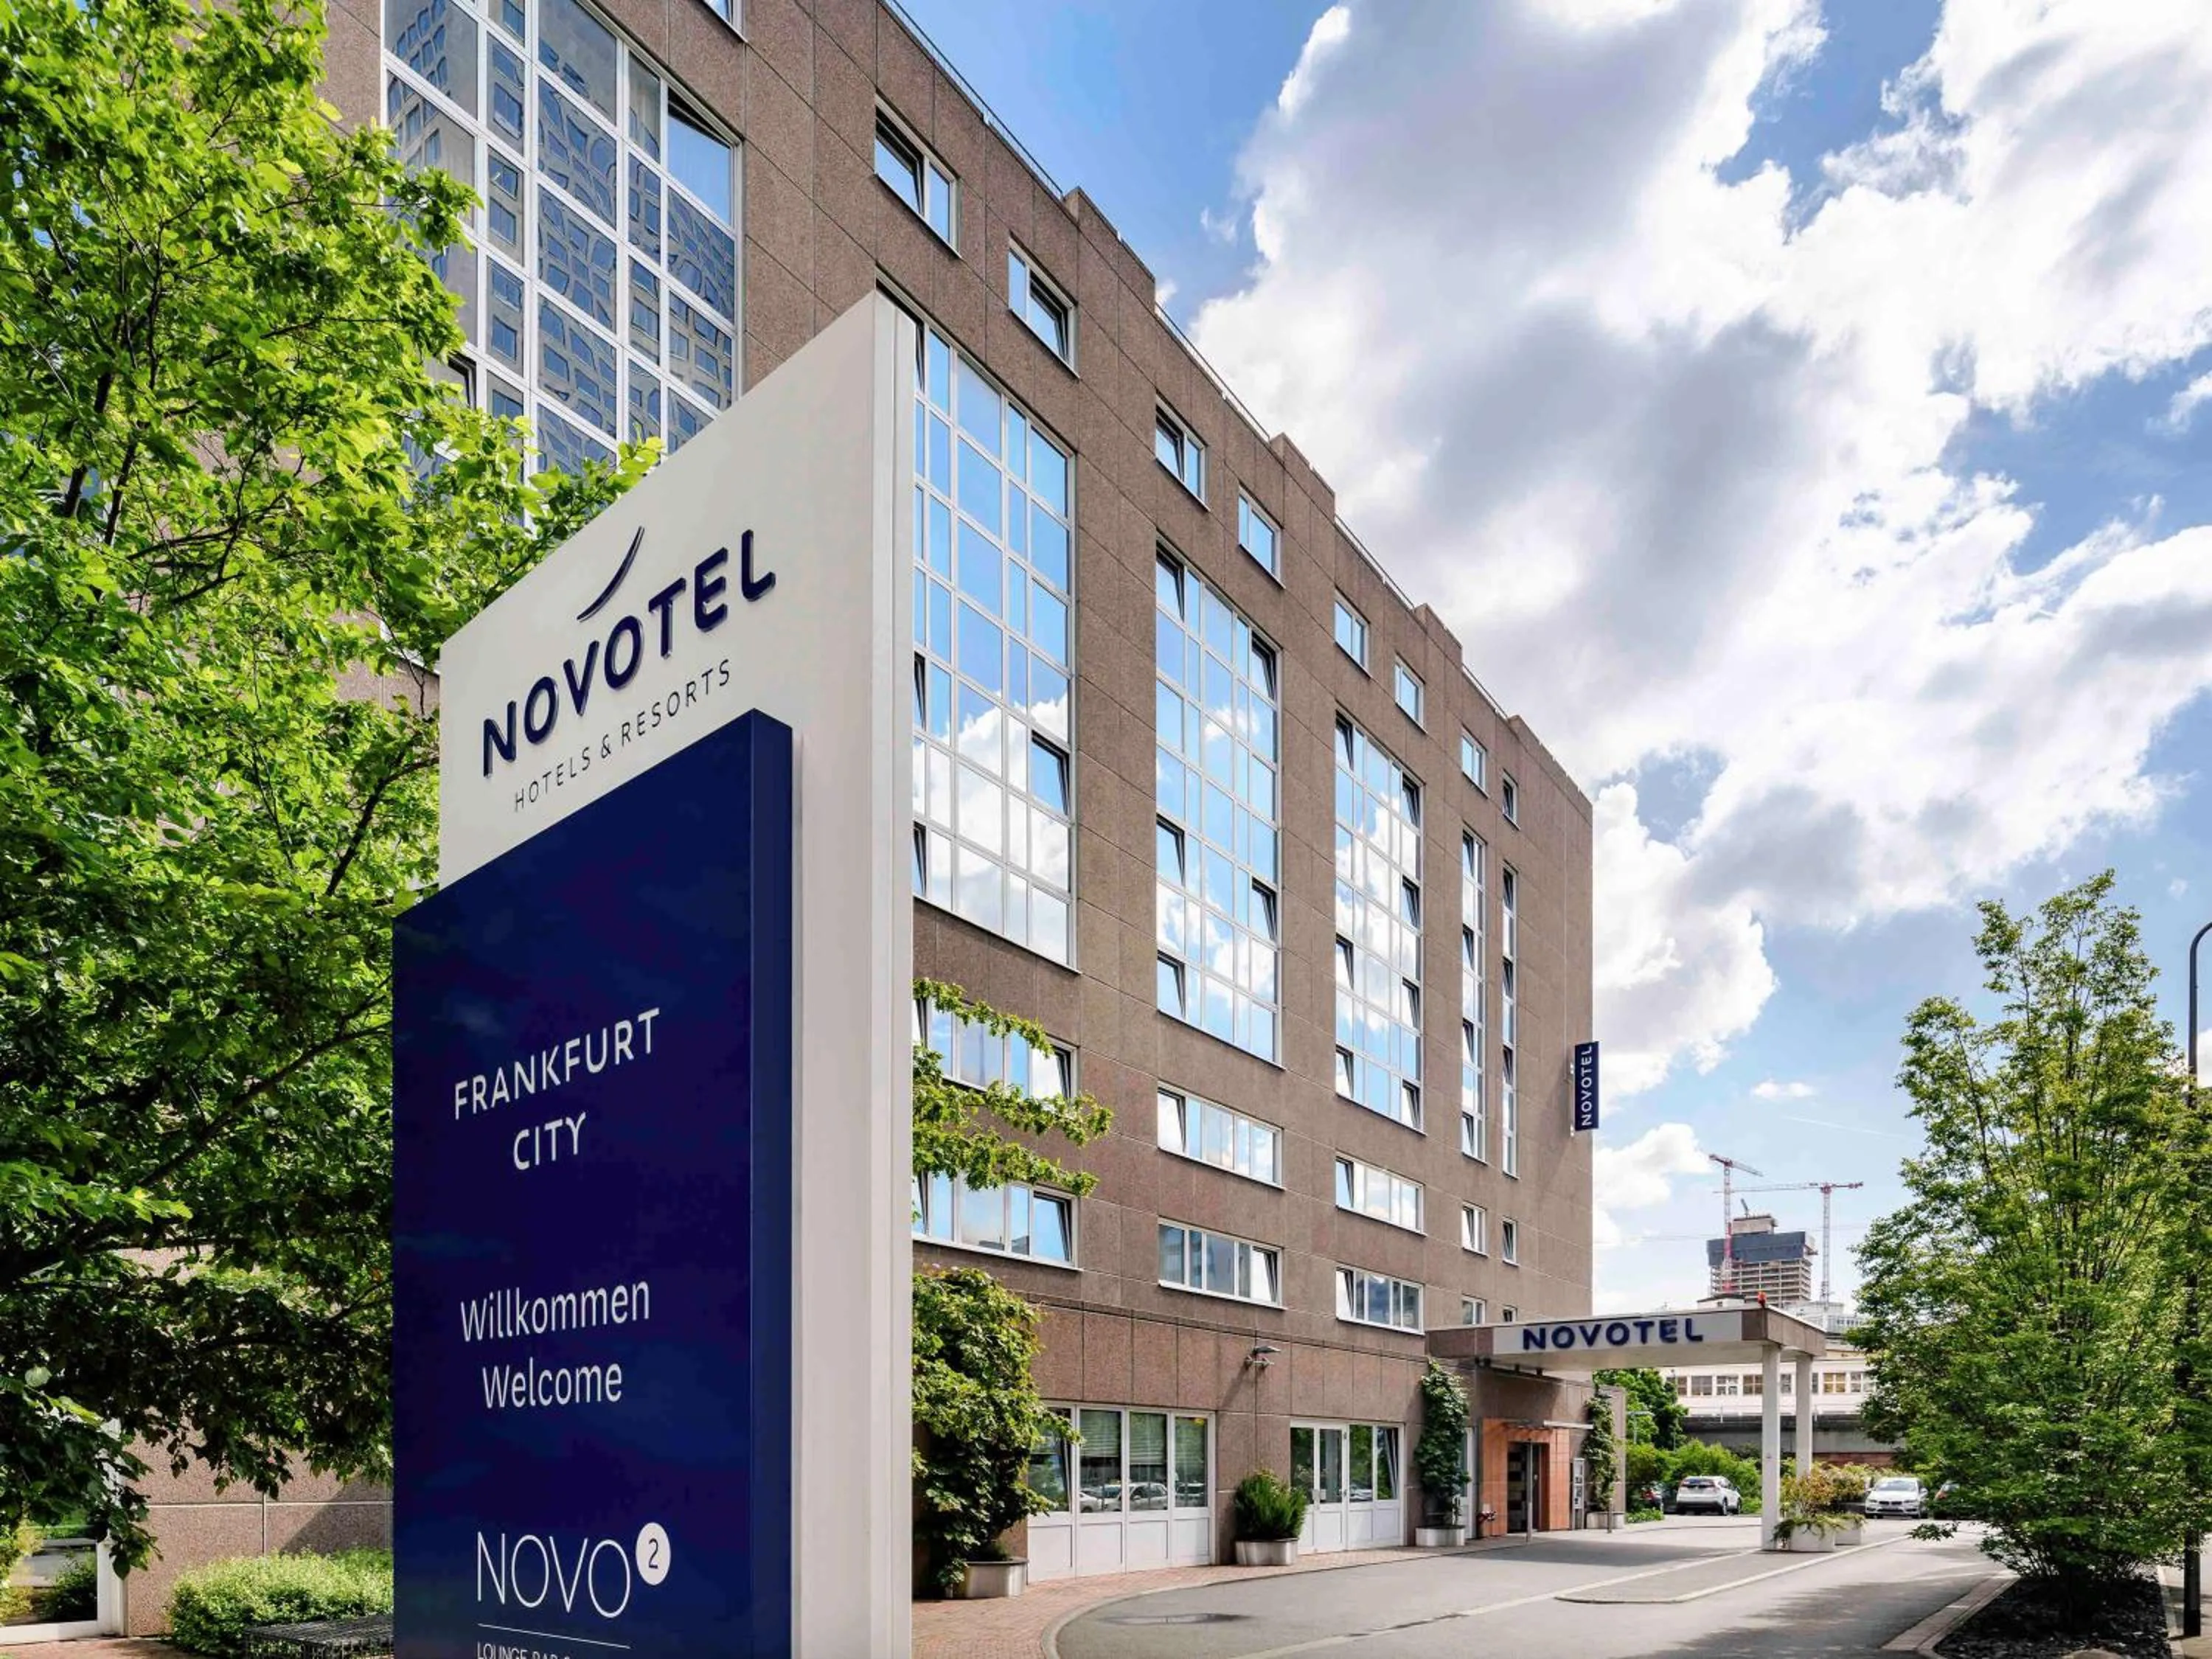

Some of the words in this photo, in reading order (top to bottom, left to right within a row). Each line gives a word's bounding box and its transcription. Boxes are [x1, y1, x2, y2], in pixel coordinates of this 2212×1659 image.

[483, 529, 776, 778] NOVOTEL
[515, 746, 591, 812] HOTELS
[600, 734, 612, 759] &
[621, 658, 731, 748] RESORTS
[454, 1007, 660, 1120] FRANKFURT
[1581, 1046, 1593, 1126] NOVOTEL
[513, 1111, 586, 1171] CITY
[460, 1280, 650, 1343] Willkommen
[1523, 1318, 1703, 1350] NOVOTEL
[482, 1357, 622, 1408] Welcome
[476, 1531, 630, 1618] NOVO
